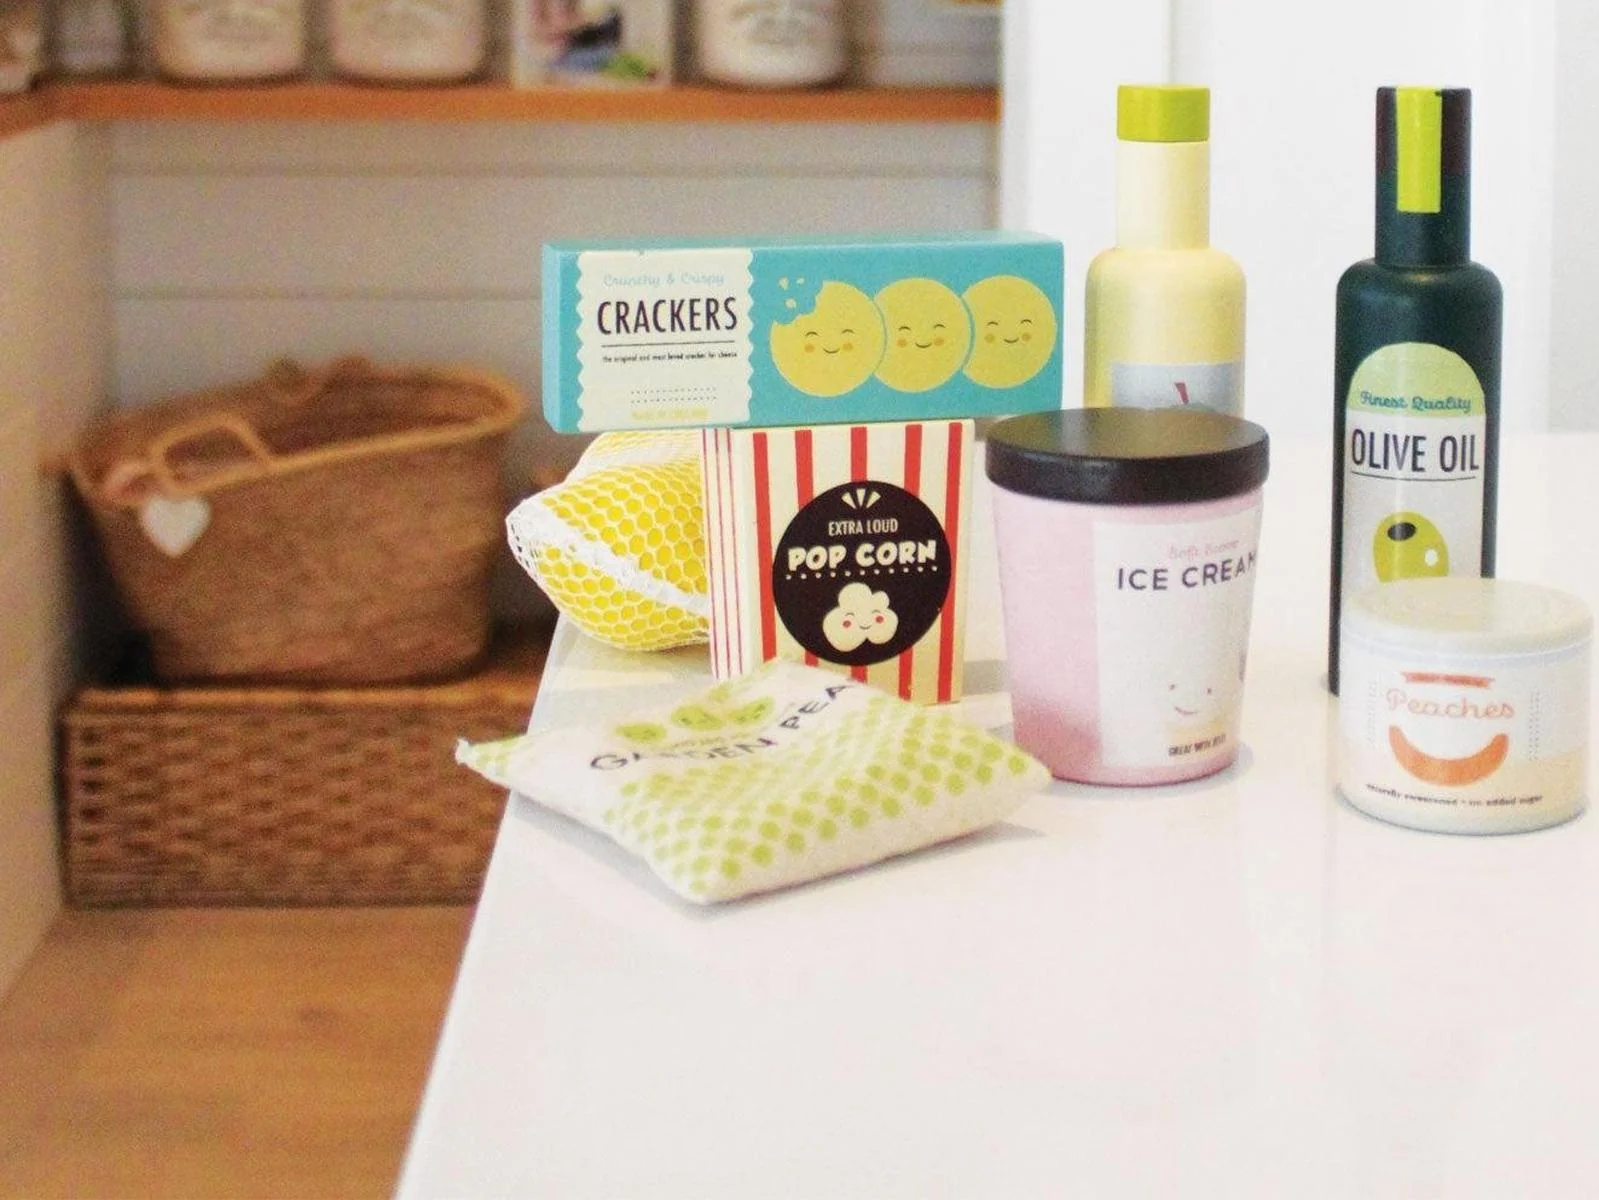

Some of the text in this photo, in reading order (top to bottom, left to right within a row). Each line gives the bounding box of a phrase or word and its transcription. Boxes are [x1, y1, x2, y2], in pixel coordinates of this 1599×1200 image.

[597, 296, 737, 334] CRACKERS
[1360, 391, 1471, 413] Finest Quality
[1352, 429, 1479, 472] OLIVE OIL
[828, 518, 898, 536] EXTRA LOUD
[788, 540, 937, 571] POP CORN
[1118, 568, 1168, 590] ICE
[1386, 688, 1515, 720] Peaches
